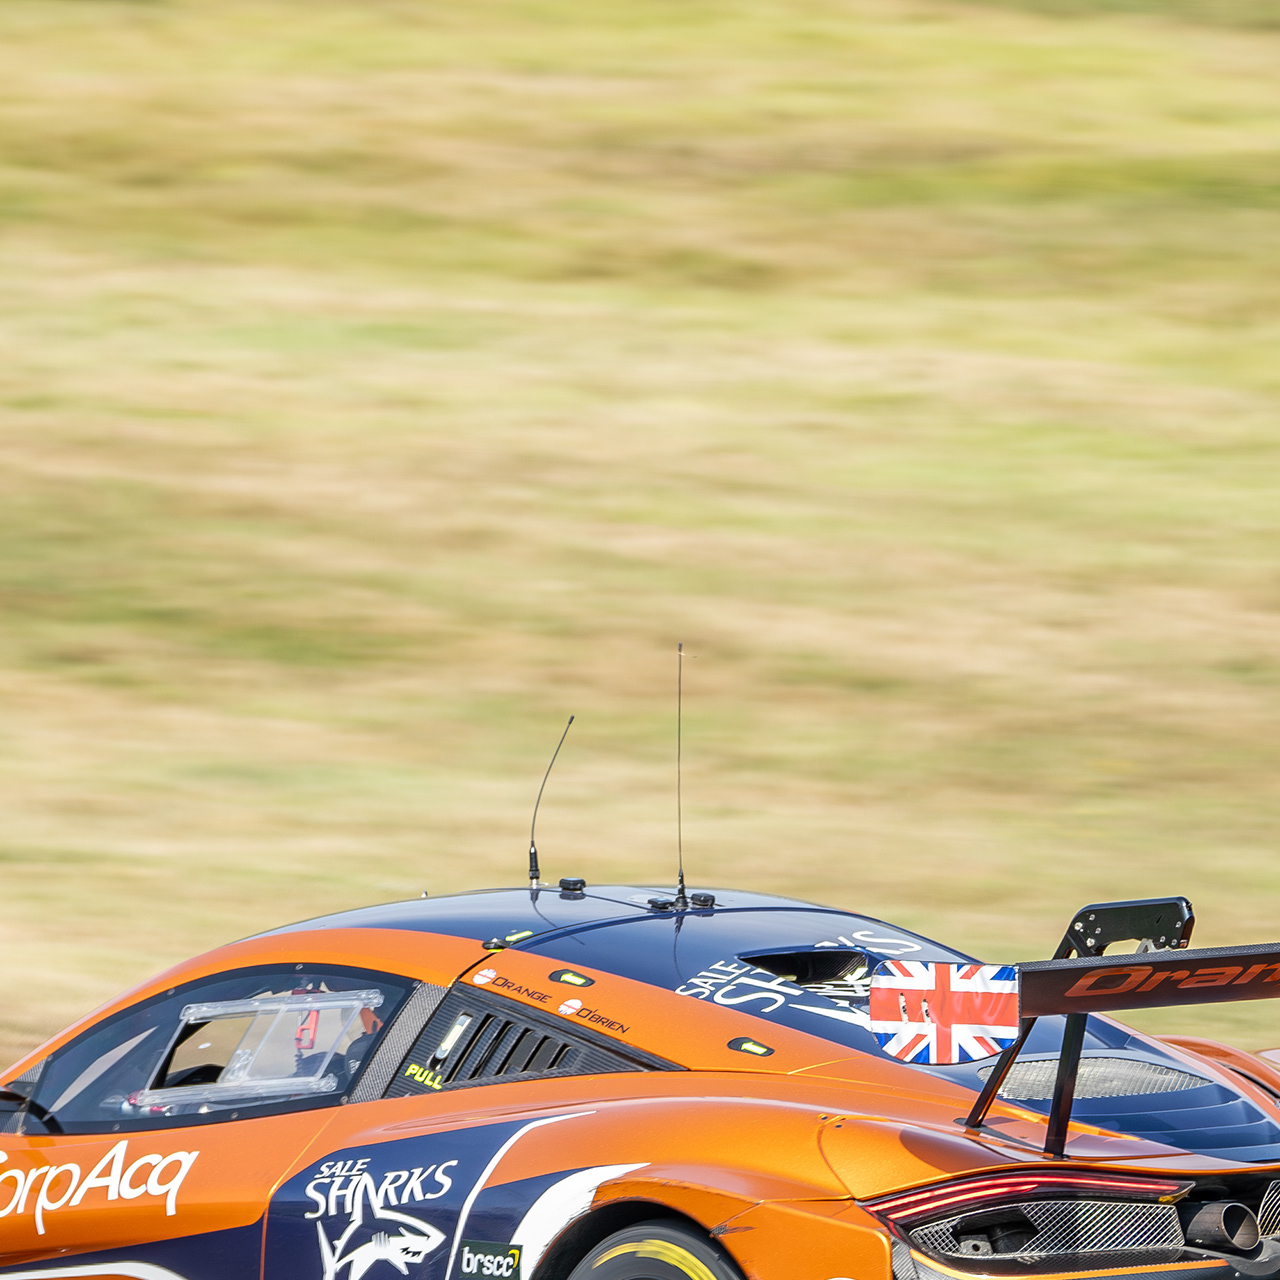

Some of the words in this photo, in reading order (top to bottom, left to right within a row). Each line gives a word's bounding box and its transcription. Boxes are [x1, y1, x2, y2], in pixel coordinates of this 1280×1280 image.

[492, 976, 553, 1004] ORANGE
[675, 960, 751, 999] SALE
[576, 1008, 631, 1034] O'BRIEN
[404, 1063, 443, 1090] PULL
[314, 1158, 372, 1179] SALE
[305, 1160, 459, 1222] SHARKS
[461, 1247, 518, 1278] brscc
